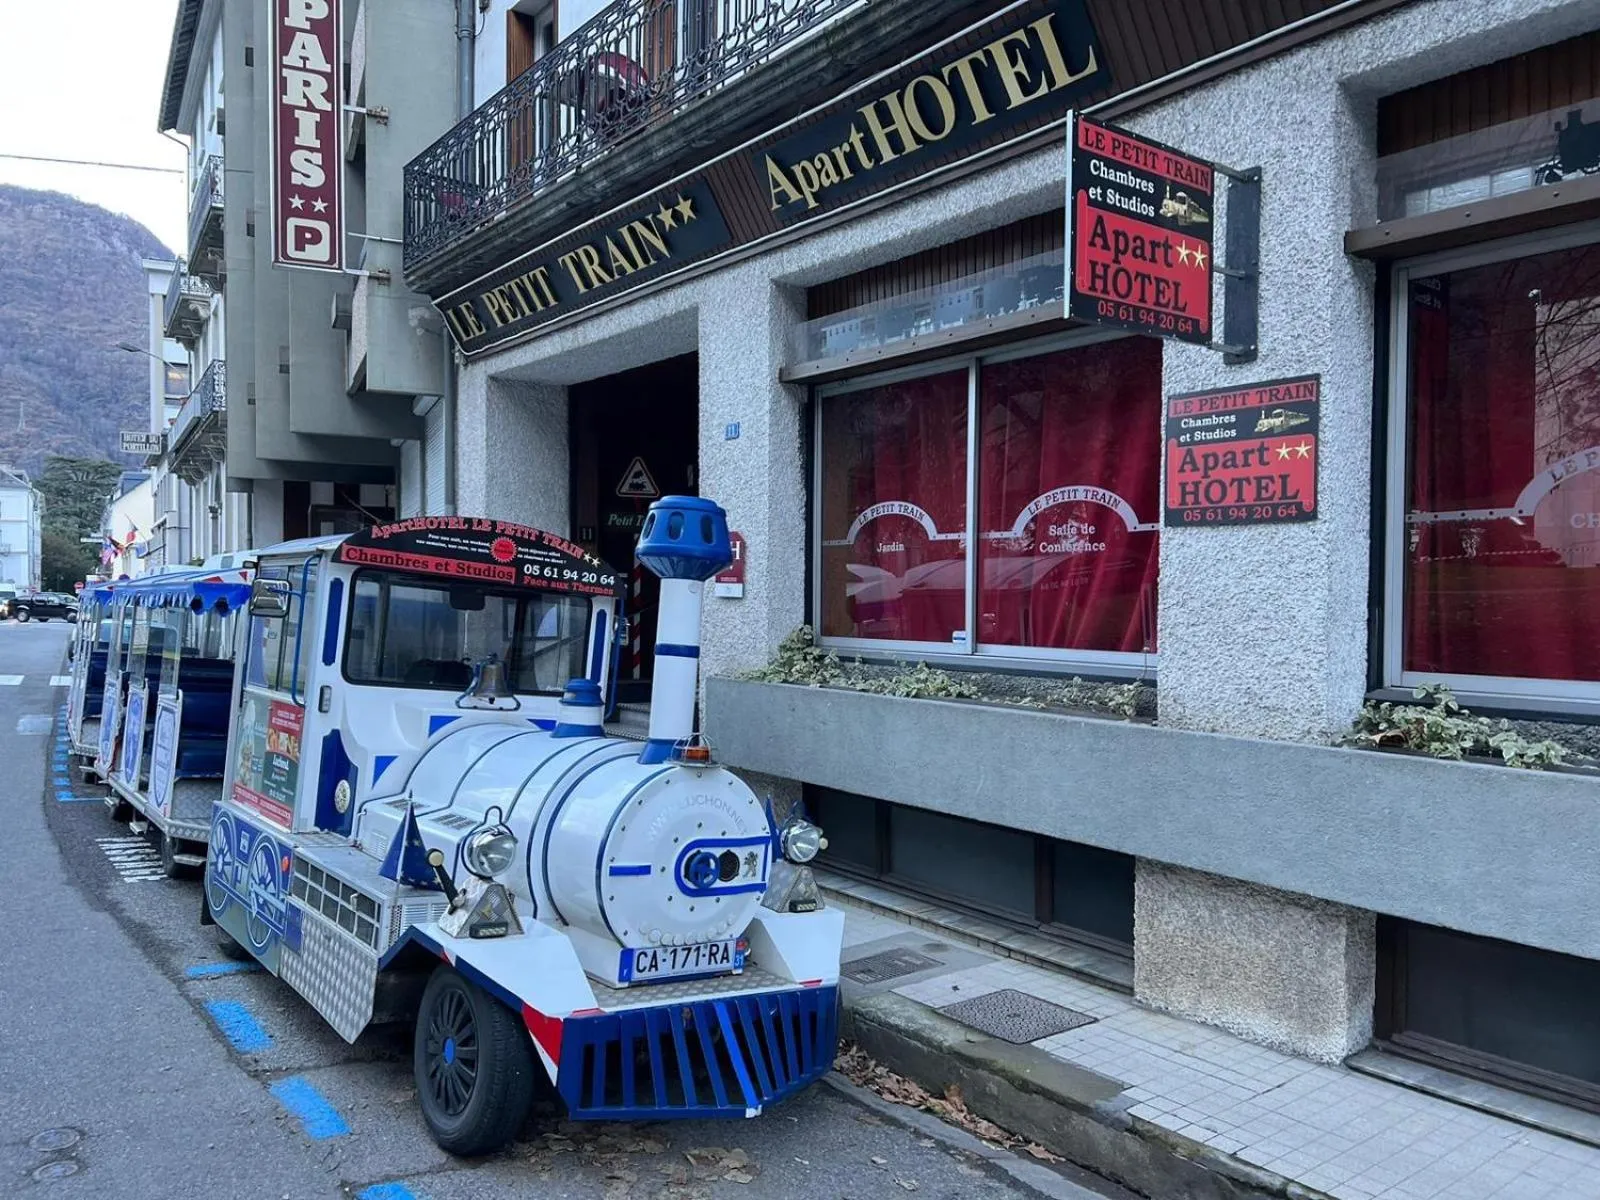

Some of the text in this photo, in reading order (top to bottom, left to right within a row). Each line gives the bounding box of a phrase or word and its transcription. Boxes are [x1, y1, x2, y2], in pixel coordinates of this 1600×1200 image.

[282, 0, 332, 188] PARIS
[764, 12, 1099, 212] ApartHOTEL
[1083, 127, 1211, 191] LE PETIT TRAIN
[1090, 158, 1155, 194] Chambres
[1088, 185, 1155, 218] et Studios
[1088, 214, 1174, 269] Apart
[446, 213, 671, 343] LE PETIT TRAIN
[1088, 259, 1188, 313] HOTEL
[1098, 300, 1193, 334] 05 61 94 20 64
[1173, 382, 1315, 414] LE PETIT TRAIN
[1180, 414, 1236, 429] Chambres
[1180, 428, 1237, 443] et Studios
[1177, 441, 1270, 479] Apart
[1028, 489, 1121, 515] LE PETIT TRAIN
[1178, 474, 1299, 507] HOTEL
[870, 503, 895, 517] PETIT
[898, 504, 925, 521] TRAIN
[1183, 505, 1298, 521] 05 61 94 20 64
[371, 516, 468, 538] ApartHOTEL
[472, 518, 492, 531] LE
[495, 520, 540, 541] PETIT
[542, 532, 586, 560] TRAIN
[1049, 523, 1096, 536] Salle de
[876, 542, 905, 553] Jardin
[345, 548, 514, 581] Chambres et Studios
[523, 563, 616, 586] 05 61 94 20 64
[523, 576, 614, 595] Face aux Thermes
[635, 942, 731, 974] CA-171-RA
[735, 955, 745, 967] 31
